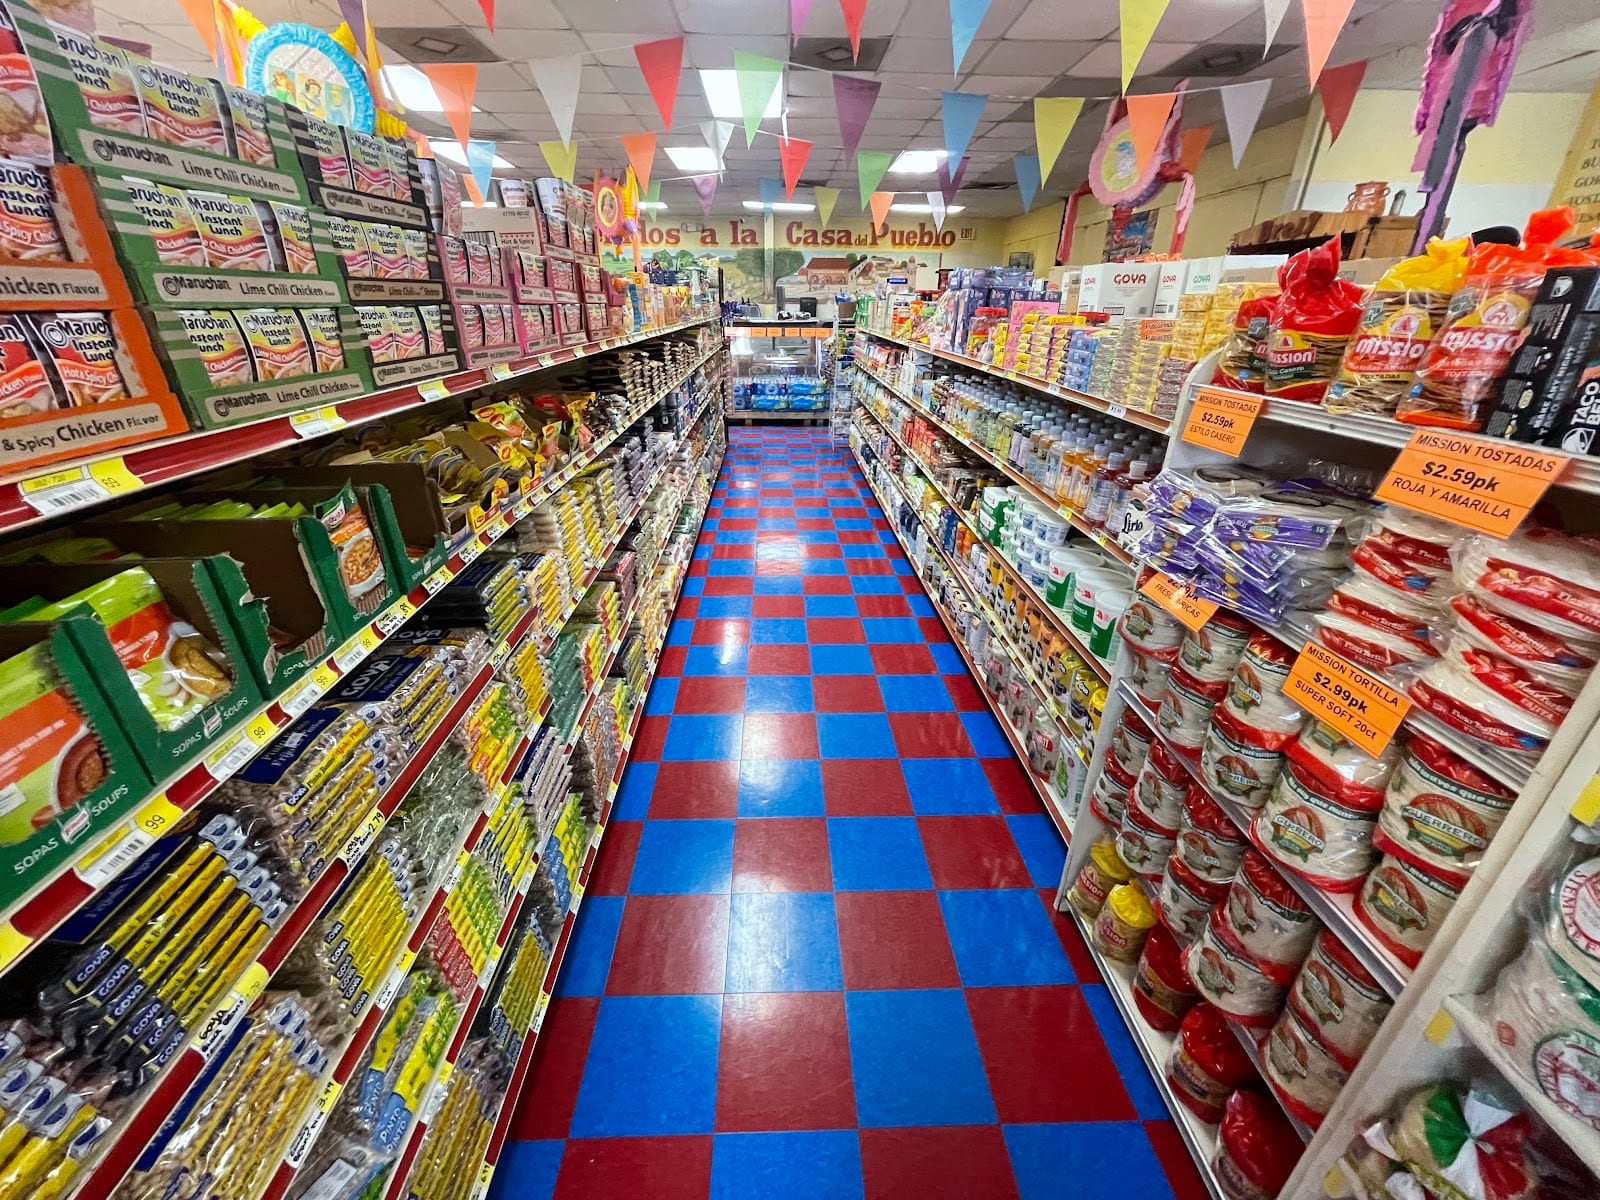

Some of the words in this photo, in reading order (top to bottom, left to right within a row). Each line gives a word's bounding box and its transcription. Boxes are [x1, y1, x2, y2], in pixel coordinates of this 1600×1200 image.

[57, 34, 122, 69] aruchan
[70, 58, 112, 79] stant
[75, 72, 111, 91] unch
[151, 65, 210, 98] Maruchan
[160, 86, 201, 108] Instant
[168, 99, 201, 118] Lunch
[306, 116, 337, 140] aruchan
[106, 139, 173, 167] Maruchan
[181, 160, 212, 180] Lime
[214, 167, 239, 185] Chili
[241, 172, 281, 193] Chicken
[0, 167, 50, 191] arucha
[0, 189, 53, 205] nstant
[130, 186, 182, 208] aruchan
[188, 196, 251, 216] Maruchan
[139, 205, 174, 219] stant
[200, 214, 242, 226] Instant
[209, 224, 242, 237] Lunch
[730, 220, 759, 245] la
[786, 220, 853, 247] Casa
[855, 234, 868, 247] del
[870, 222, 957, 247] Pueblo
[63, 284, 100, 296] Flavor
[174, 274, 231, 291] Maruchan
[240, 282, 266, 296] Lime
[268, 284, 289, 297] Chili
[290, 284, 324, 297] Chicken
[1084, 277, 1097, 285] GOYA
[1113, 273, 1147, 285] GOYA
[1162, 274, 1177, 284] GOYA
[1193, 273, 1211, 284] GOYA
[184, 316, 231, 331] aruchan
[253, 314, 295, 327] Maruchan
[360, 311, 388, 321] aruchan
[361, 322, 383, 330] nstant
[189, 332, 225, 343] nstant
[262, 328, 291, 338] Instant
[1442, 329, 1519, 353] missio
[71, 339, 114, 352] Instan
[84, 350, 113, 363] Lunc
[199, 343, 225, 353] unch
[1356, 336, 1425, 359] missio
[226, 391, 271, 409] Maruchan
[276, 391, 300, 403] Lime
[300, 387, 319, 398] Chili
[319, 382, 350, 396] Chicken
[1199, 395, 1224, 408] MISSION
[1224, 399, 1258, 415] TOSTADAS
[1571, 381, 1600, 426] TACO
[1201, 412, 1236, 430] $2.59pk
[2, 439, 16, 451] &
[16, 434, 56, 453] Spicy
[56, 416, 126, 443] Chicken
[1189, 425, 1211, 438] ESTILO
[1210, 430, 1236, 445] CASERO
[1416, 434, 1472, 455] MISSION
[1474, 446, 1557, 473] TOSTADAS
[1421, 461, 1501, 493] $2.59pk
[1391, 476, 1426, 496] ROJA
[1429, 487, 1440, 497] Y
[1440, 488, 1511, 521] AMARILLA
[1306, 645, 1347, 676] MISSION
[1349, 670, 1399, 708] TORTILLA
[1313, 670, 1368, 714] $2.99pk
[1295, 679, 1326, 706] SUPER
[1326, 700, 1354, 723] SOFT
[1353, 719, 1377, 740] 20ct
[171, 730, 202, 758] SOPAS
[223, 696, 249, 720] SOUPS
[14, 836, 60, 876] SOPAS
[91, 783, 130, 817] SOUPS
[1403, 805, 1487, 850] GUERRERO
[76, 947, 111, 983] GOYA
[98, 963, 131, 999] GOYA
[114, 984, 145, 1017] GOYA
[132, 1001, 162, 1037] GOYA
[149, 1013, 176, 1047] GOYA
[159, 1030, 186, 1065] GOYA
[379, 1106, 402, 1144] PINTO
